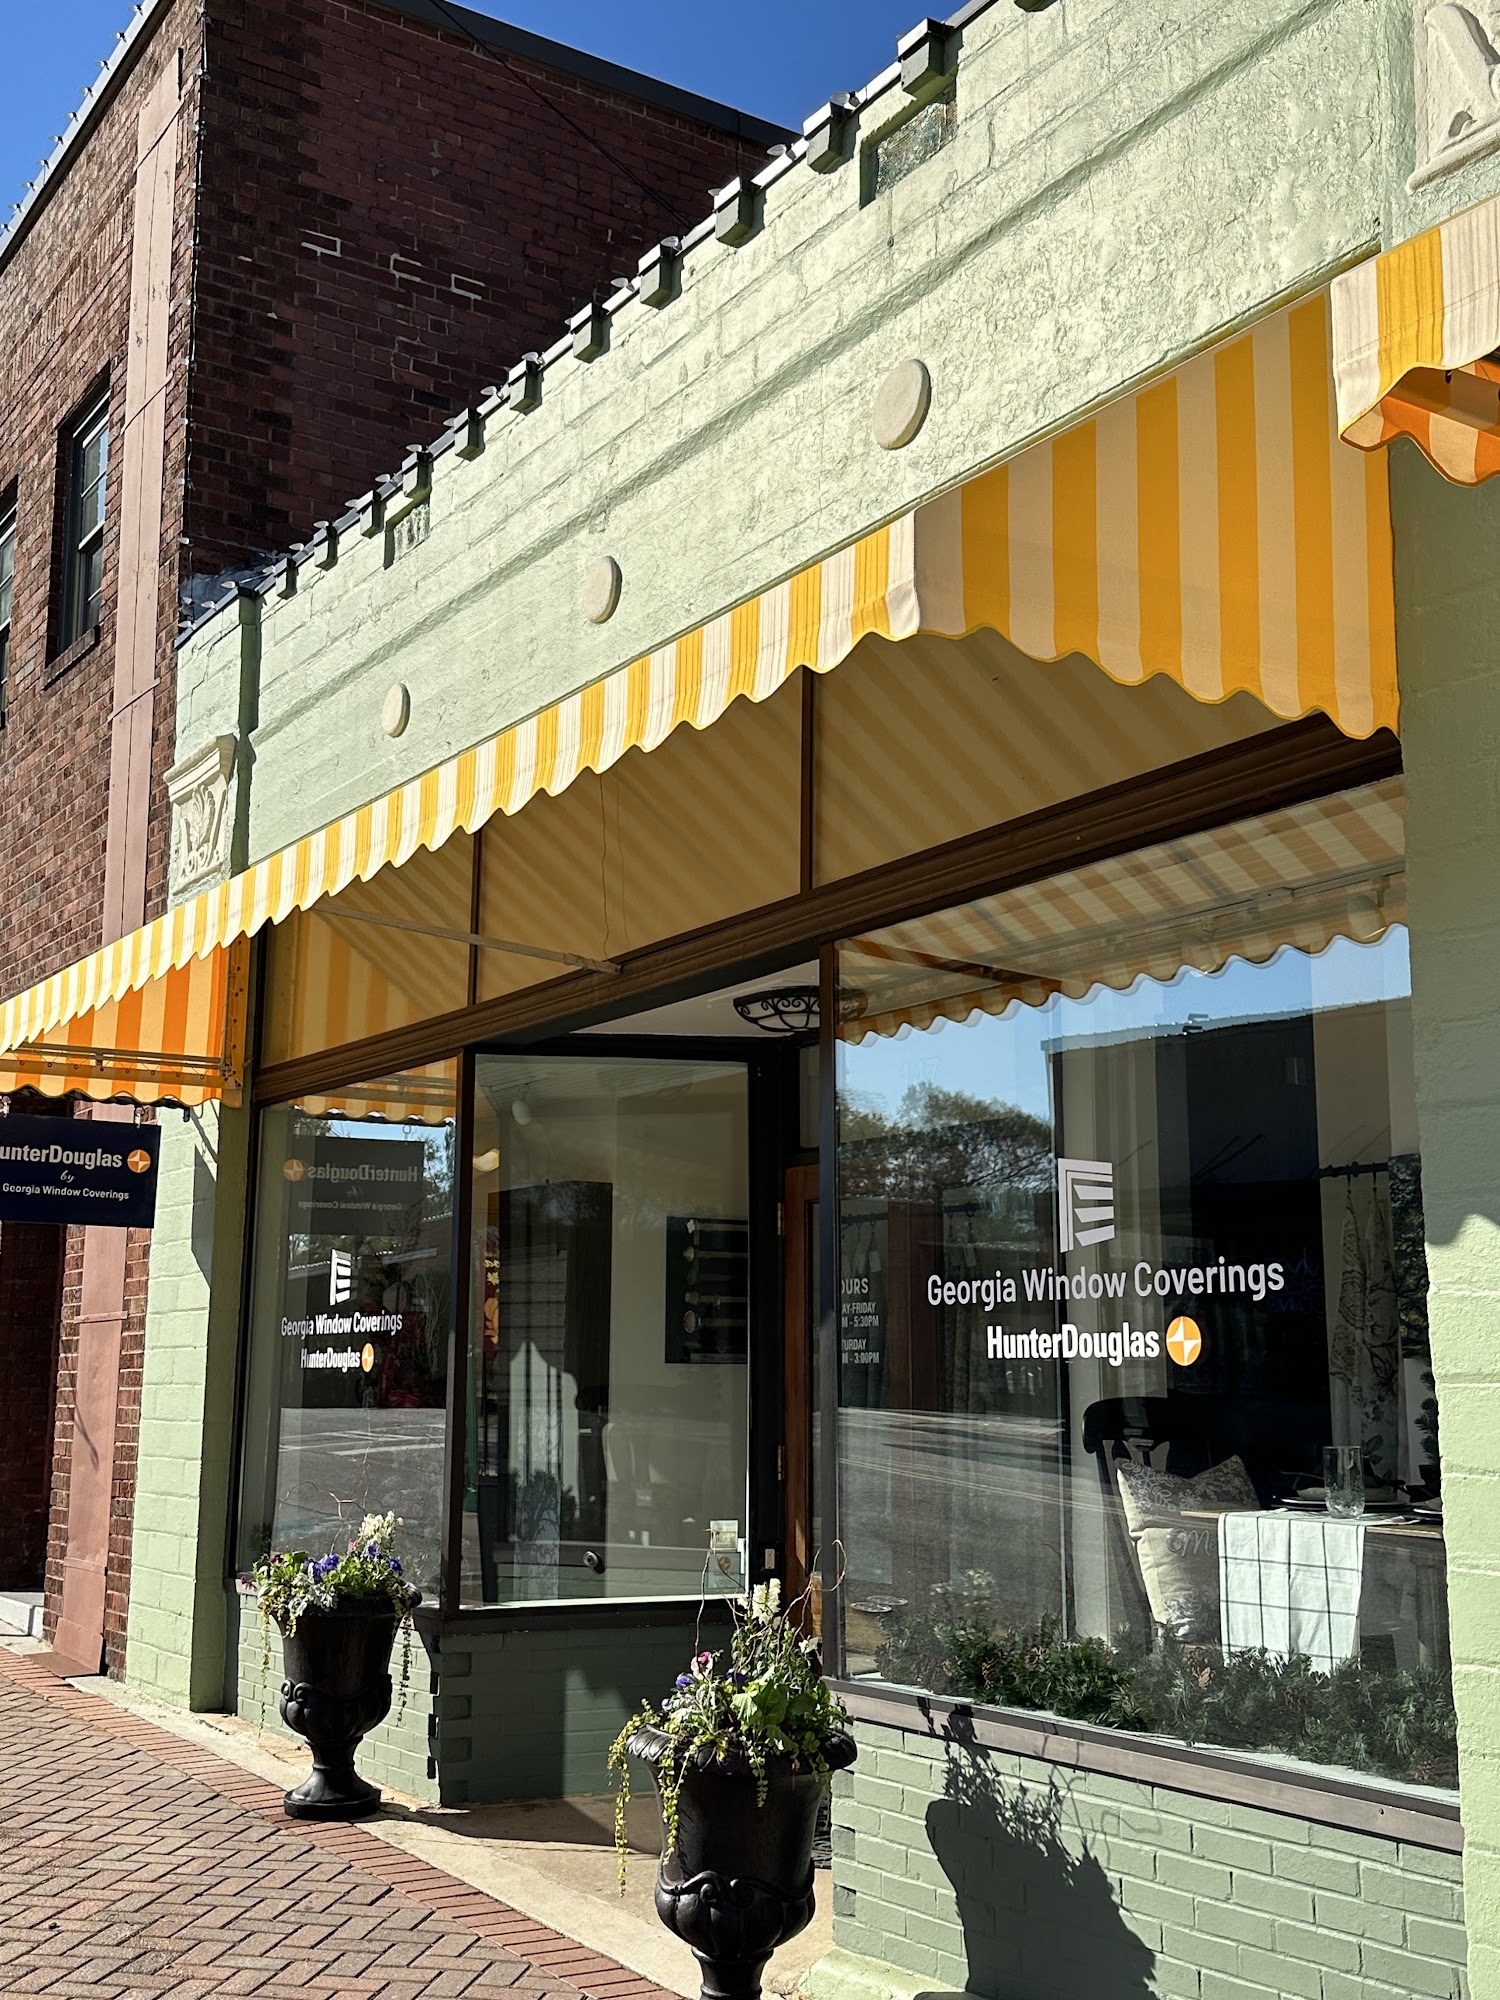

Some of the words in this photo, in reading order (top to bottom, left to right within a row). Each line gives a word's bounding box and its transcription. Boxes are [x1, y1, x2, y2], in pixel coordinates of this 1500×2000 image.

[0, 1144, 123, 1170] unterDouglas
[60, 1169, 76, 1183] by
[2, 1183, 41, 1196] Georgia
[42, 1185, 81, 1197] Window
[82, 1188, 130, 1201] Coverings
[842, 1278, 869, 1294] URS
[927, 1270, 1017, 1312] Georgia
[1022, 1266, 1126, 1302] Window
[1134, 1256, 1285, 1301] Coverings
[842, 1302, 876, 1315] AY-FRIDAY
[281, 1315, 314, 1340] Georgia
[315, 1313, 352, 1335] Window
[353, 1309, 403, 1336] Coverings
[854, 1315, 879, 1327] 5:30PM
[842, 1338, 867, 1351] TURDAY
[987, 1322, 1160, 1367] HunterDouglas
[301, 1346, 360, 1373] HunterDouglas
